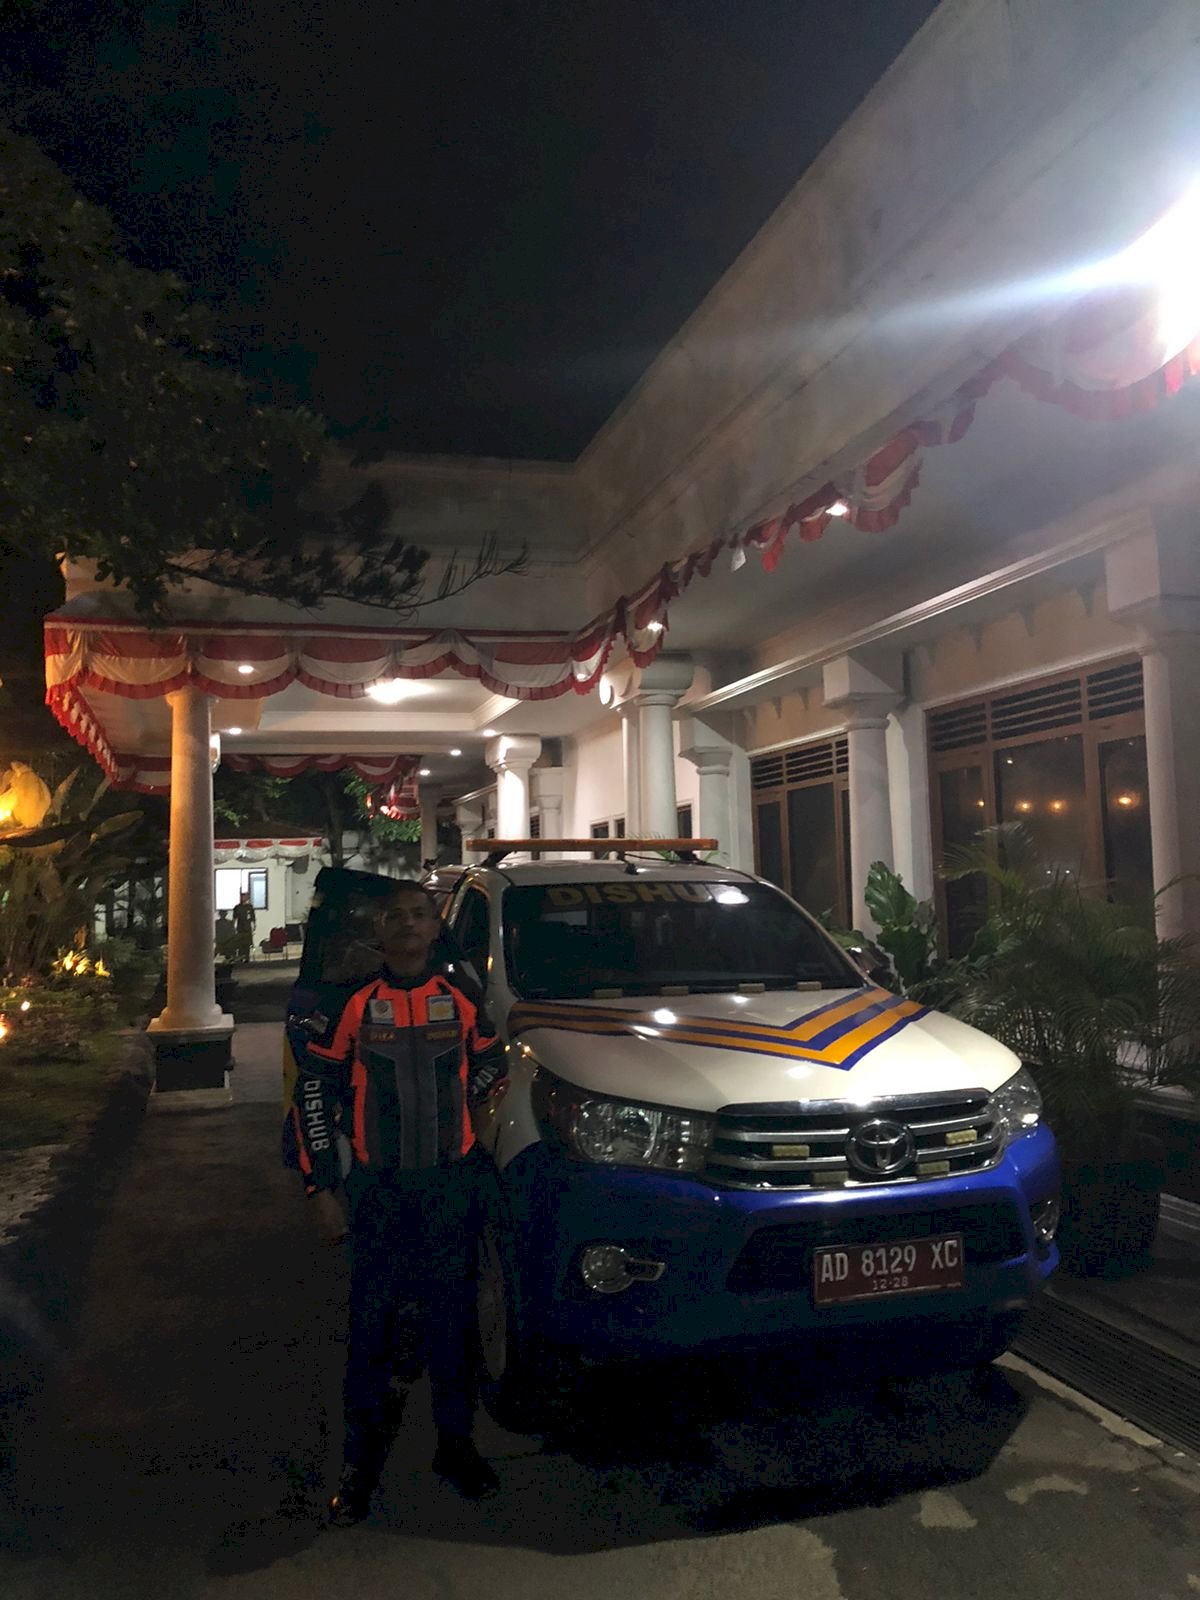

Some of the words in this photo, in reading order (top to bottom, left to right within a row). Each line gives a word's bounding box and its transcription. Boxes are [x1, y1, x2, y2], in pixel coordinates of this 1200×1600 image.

[304, 1080, 330, 1151] DISHUB
[821, 1253, 848, 1282] AD
[861, 1246, 917, 1276] 8129
[931, 1240, 959, 1270] XC
